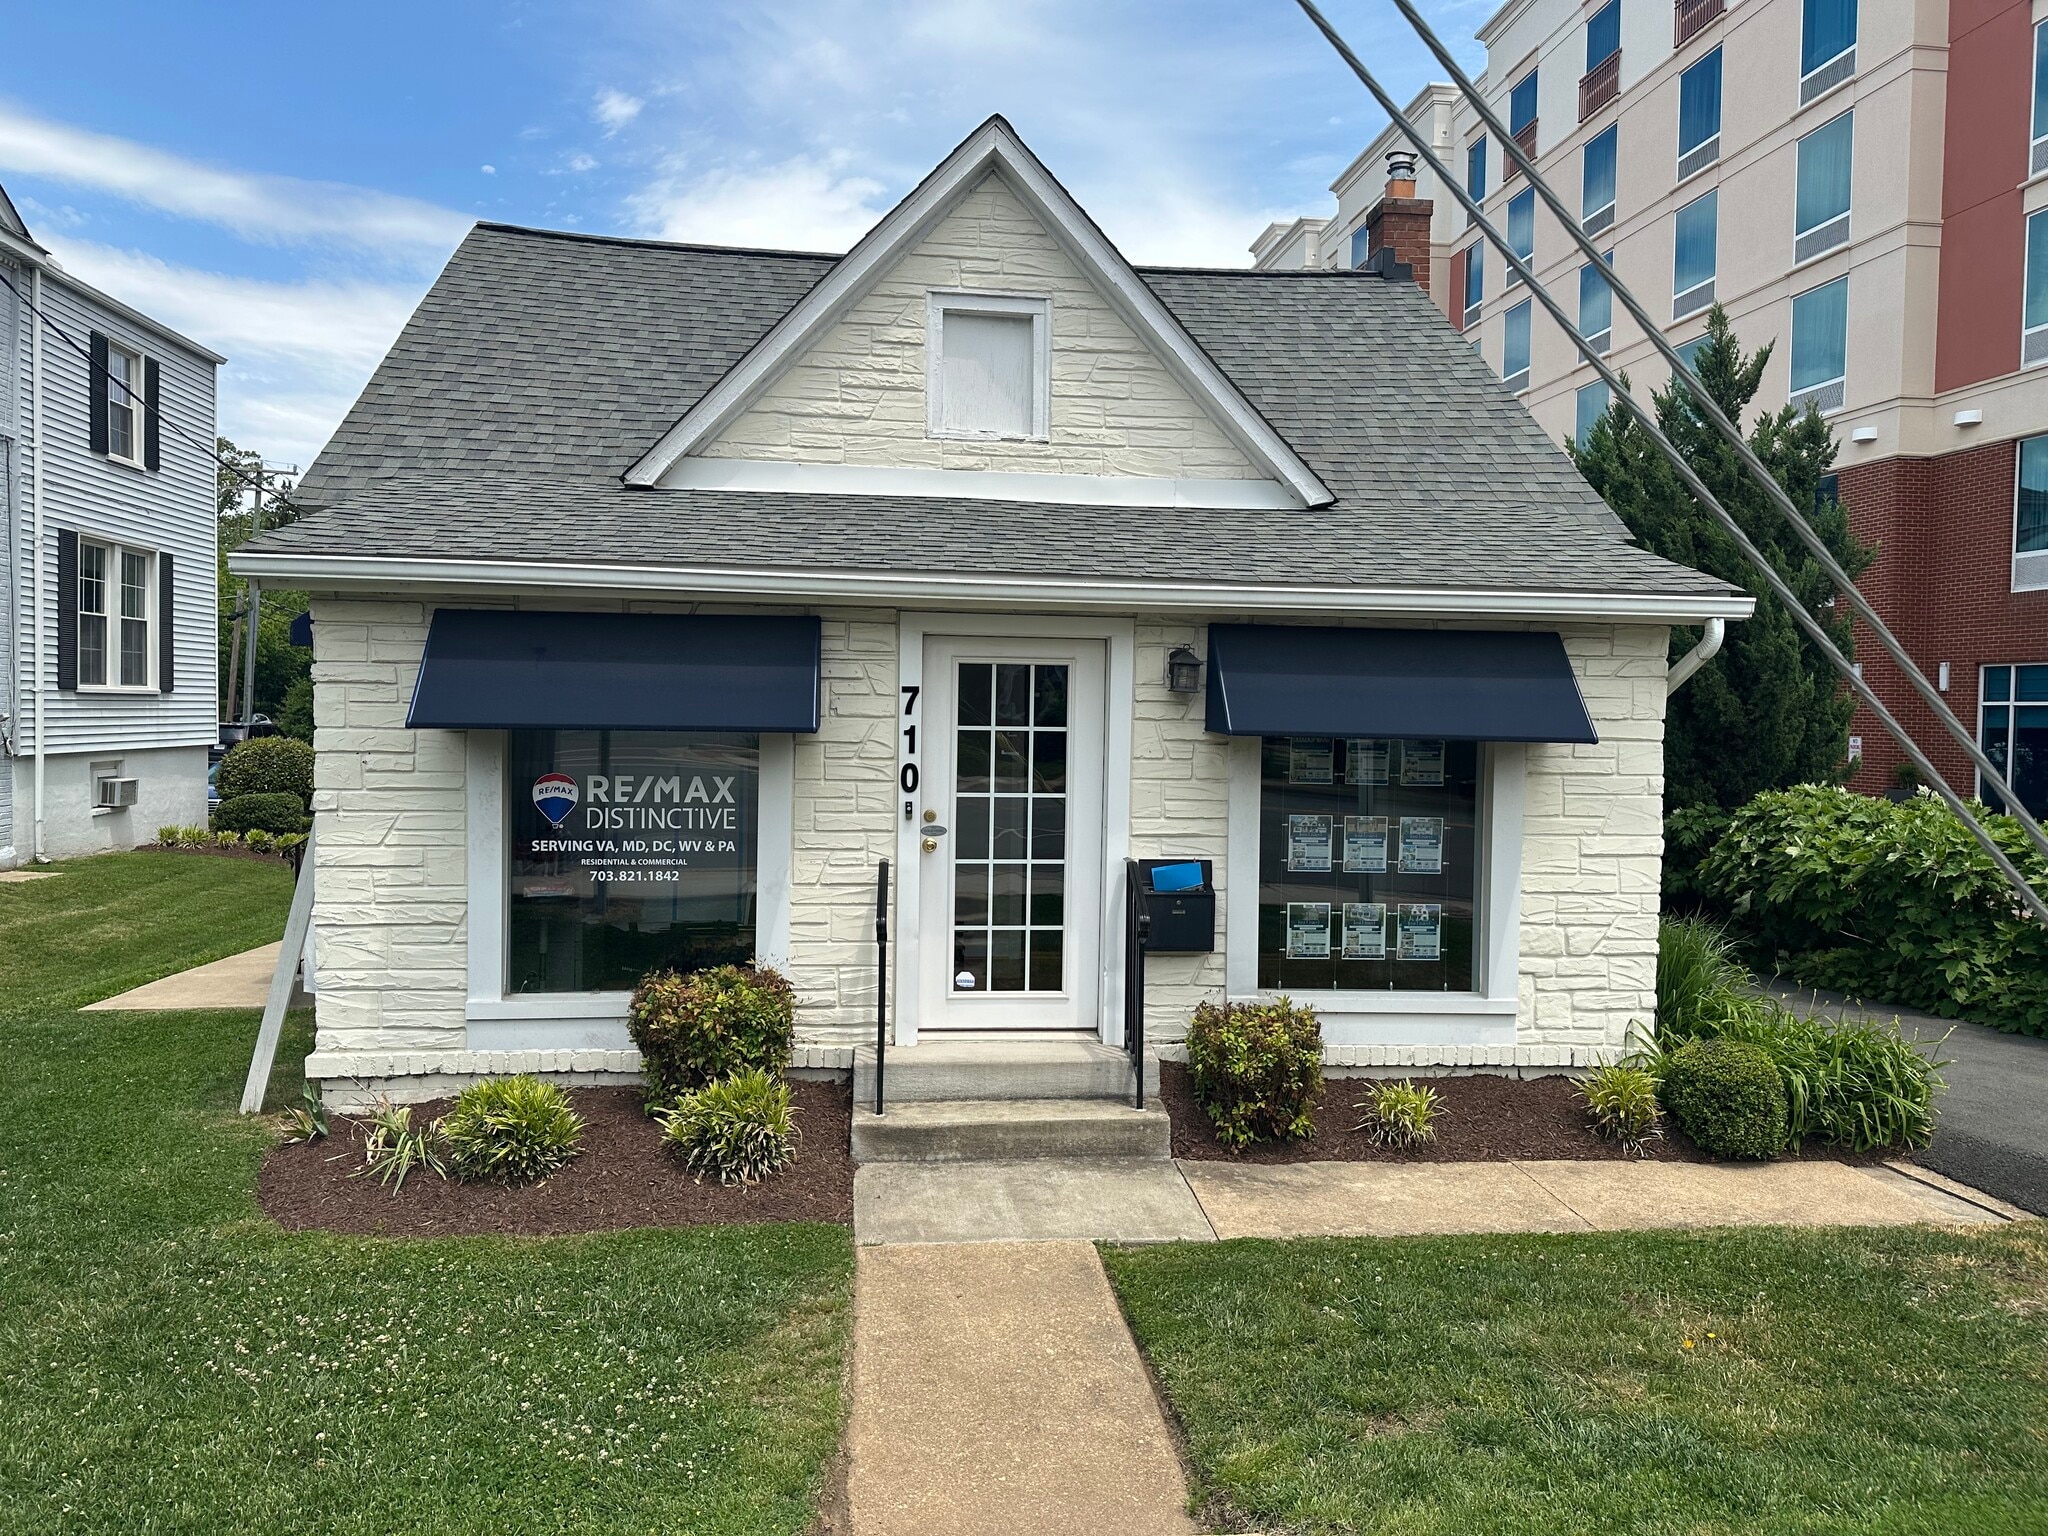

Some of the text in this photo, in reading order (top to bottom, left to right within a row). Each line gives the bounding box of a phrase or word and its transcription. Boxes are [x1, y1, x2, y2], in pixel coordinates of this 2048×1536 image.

[900, 686, 920, 793] 710
[538, 786, 573, 796] RE/MAX
[587, 775, 736, 803] RE/MAX
[586, 807, 736, 829] DISTINCTIVE
[531, 840, 736, 853] SERVING VA, MD, DC, WV & PA
[581, 858, 688, 866] RESIDENTIAL & COMMERCIAL
[589, 870, 680, 882] 703.821.1842
